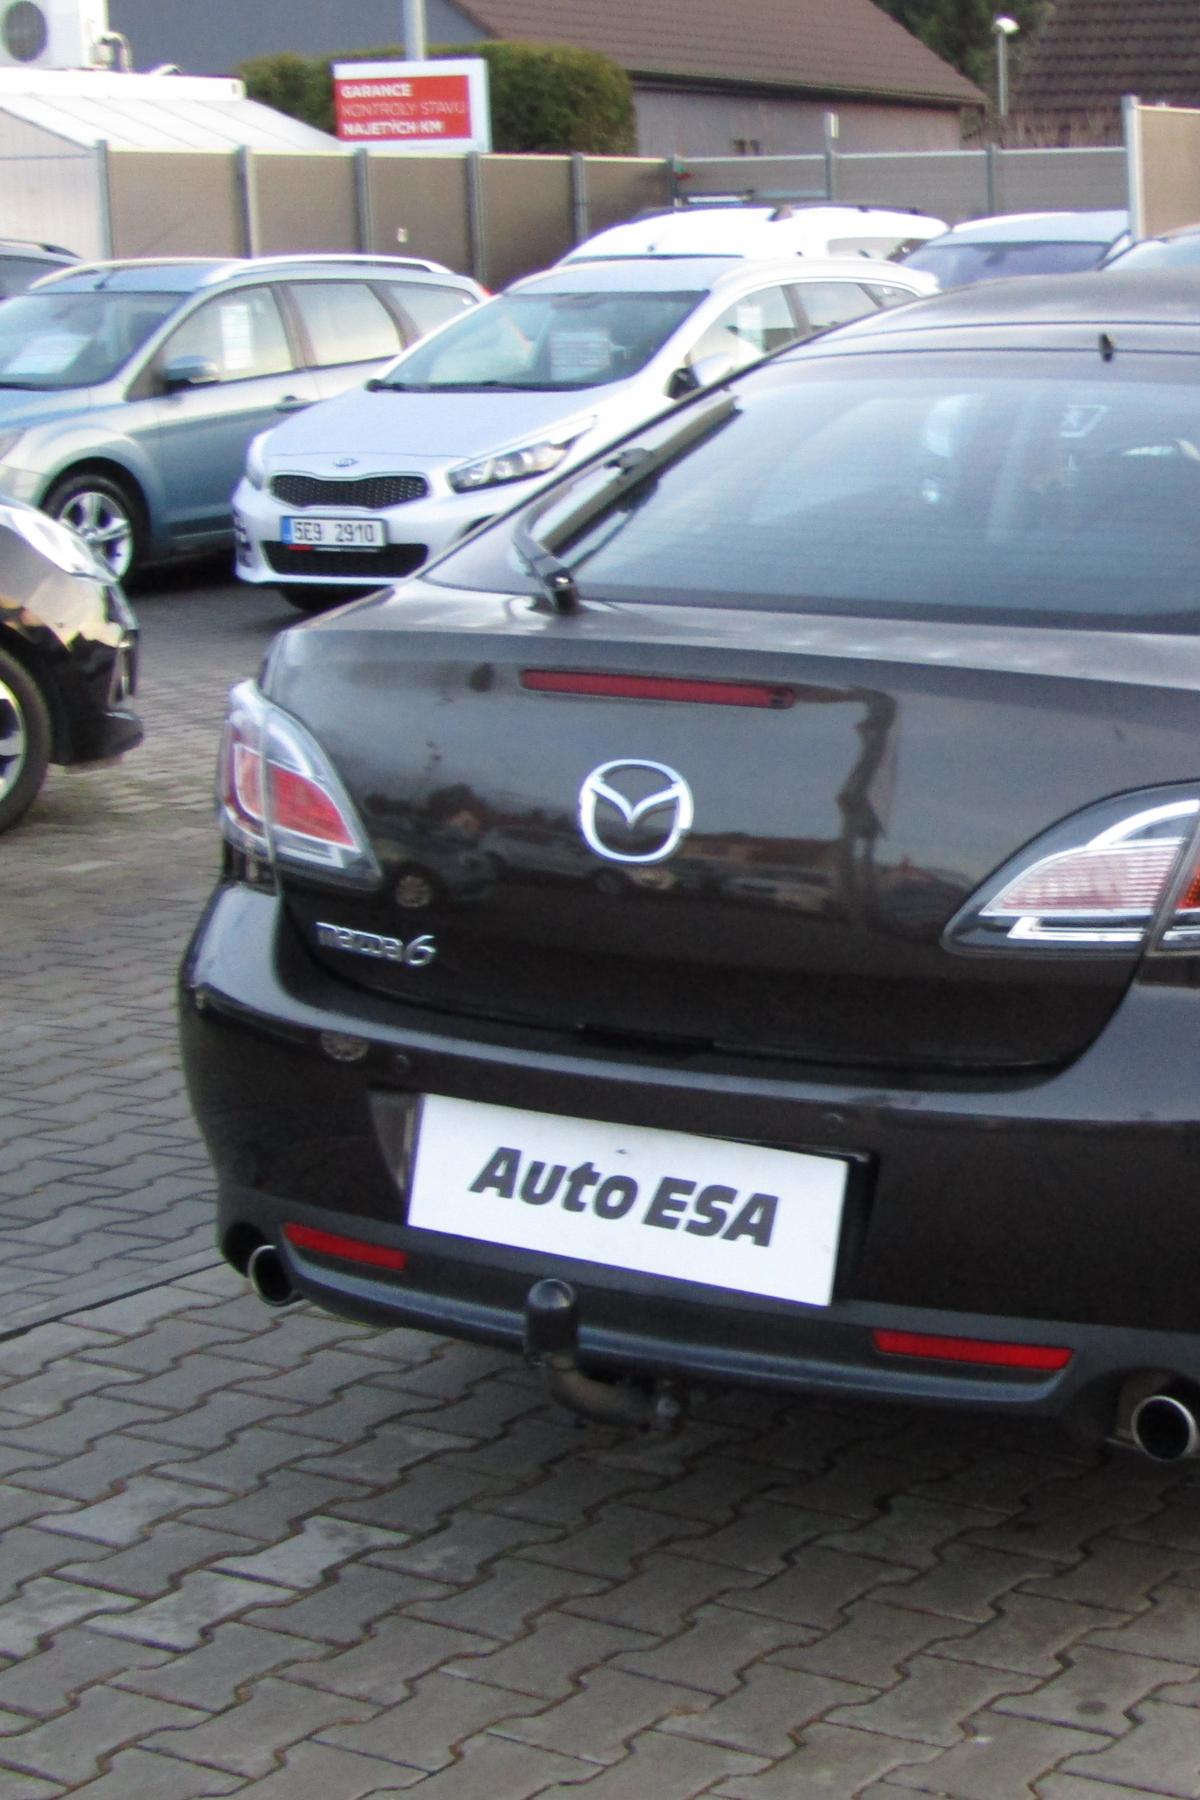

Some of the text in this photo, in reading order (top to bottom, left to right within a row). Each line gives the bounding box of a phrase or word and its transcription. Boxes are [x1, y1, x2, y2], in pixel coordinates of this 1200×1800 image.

[341, 83, 412, 98] GARANCE
[342, 101, 465, 117] KONTROLY STAVU
[420, 121, 443, 133] KM
[295, 521, 374, 542] 5E9 2910
[469, 1146, 780, 1247] Auto ESA
